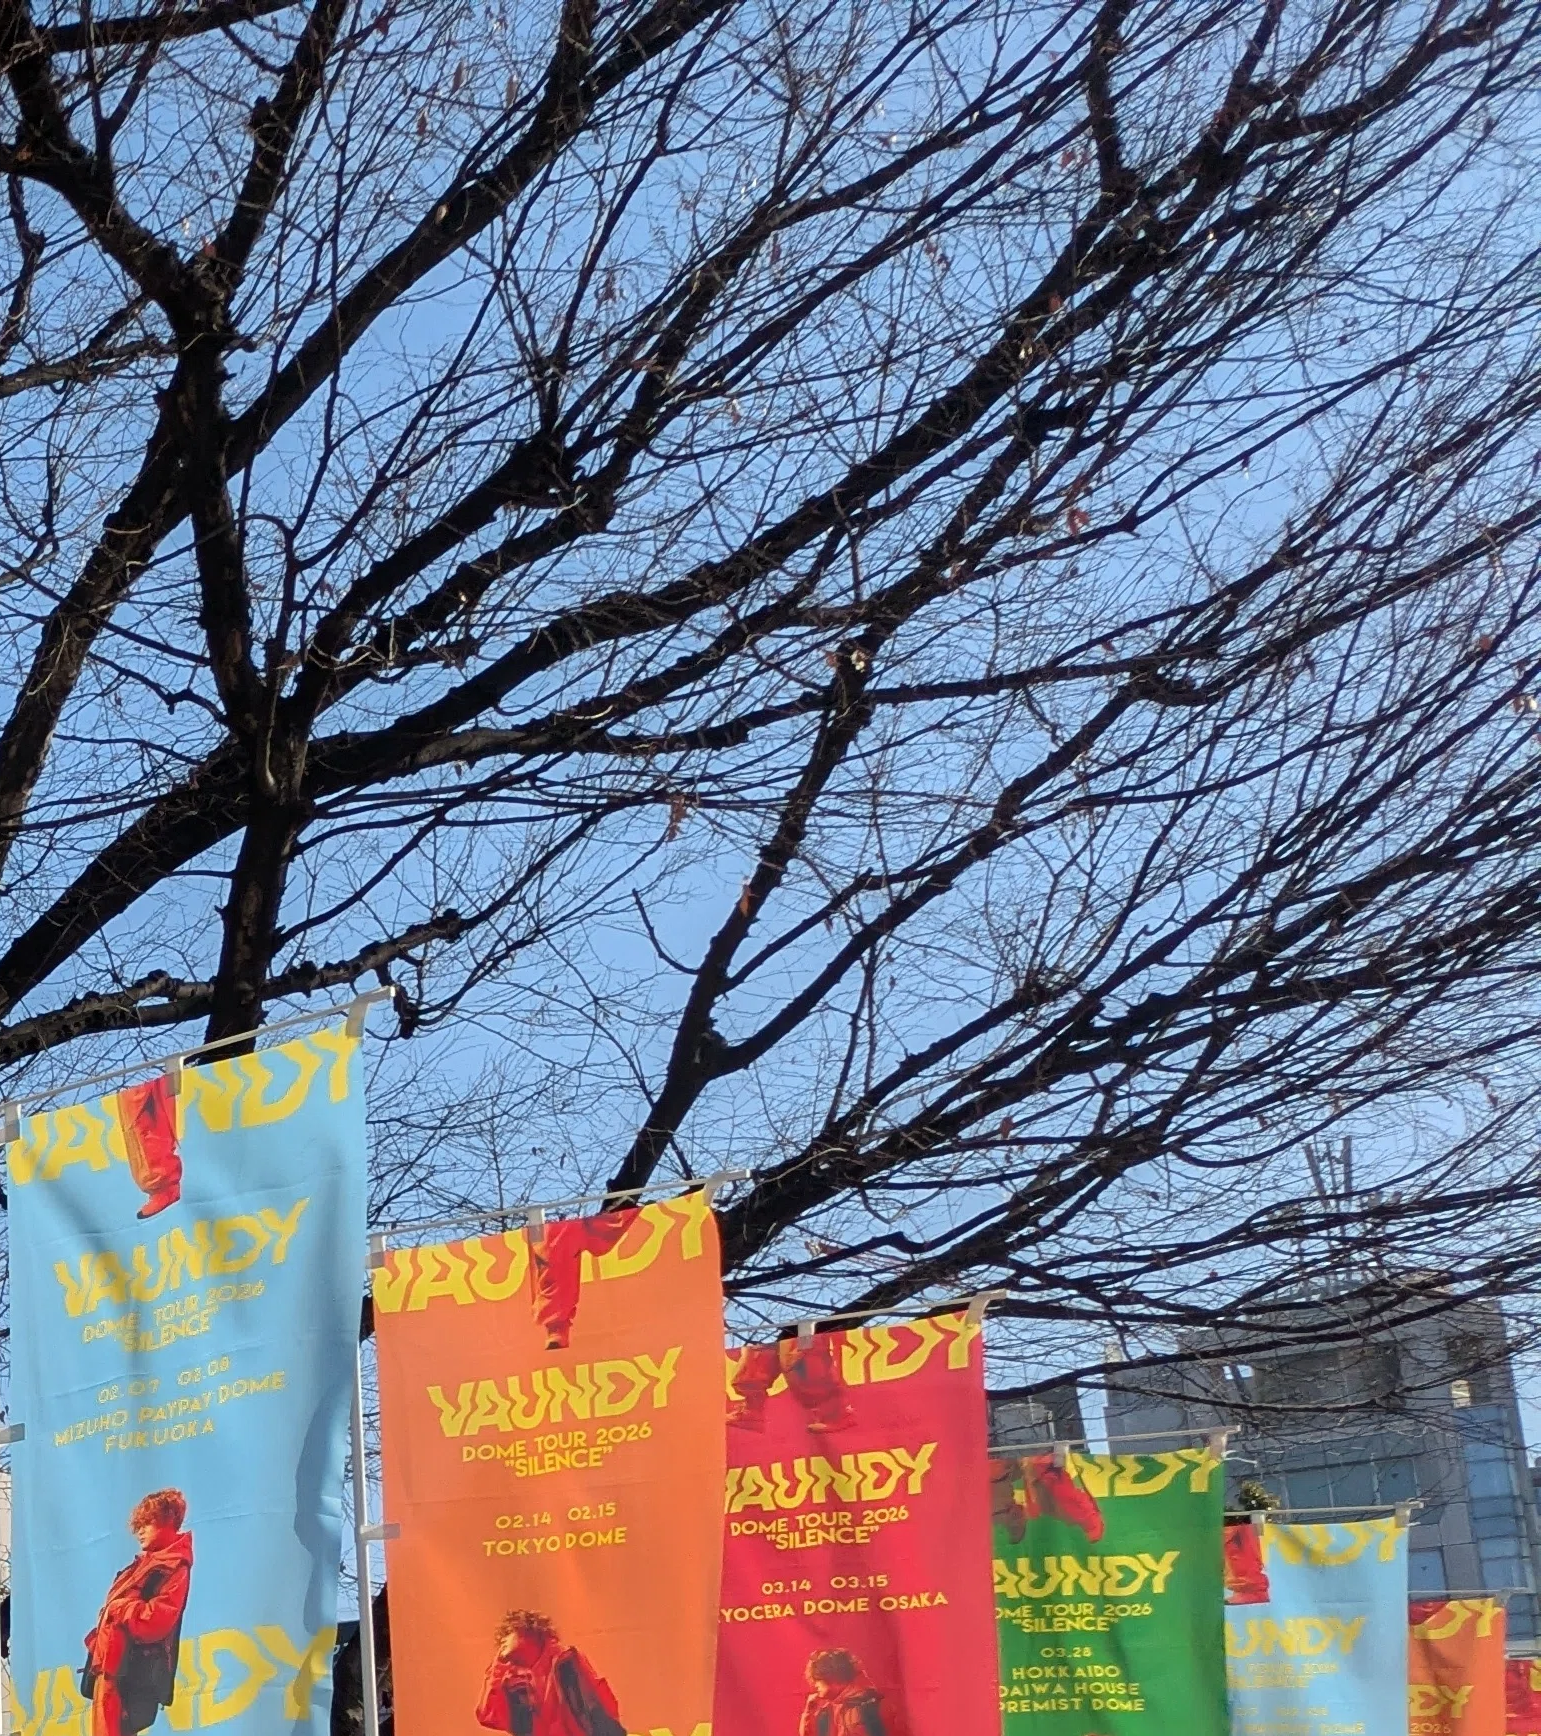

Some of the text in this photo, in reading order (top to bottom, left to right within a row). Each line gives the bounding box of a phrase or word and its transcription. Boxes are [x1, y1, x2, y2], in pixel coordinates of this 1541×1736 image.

[53, 1197, 312, 1319] VAUNDY
[82, 1310, 142, 1345] DOME
[153, 1293, 201, 1326] TOUR
[426, 1345, 683, 1438] VAUNDY
[53, 1369, 287, 1448] MIZUHO PAYPAY DOME
[462, 1421, 653, 1463] DOME TOUR 2026
[495, 1502, 617, 1530] 02.14 02.15
[730, 1504, 910, 1537] DOME TOUR 2026
[482, 1526, 628, 1557] TOKYO DOME
[761, 1574, 889, 1596] 03.14 03.15
[718, 1591, 949, 1625] YOCERA DOME OSAKA
[1042, 1602, 1095, 1618] TOUR
[1104, 1602, 1153, 1618] 2026
[1039, 1646, 1093, 1659] 03.28
[1012, 1665, 1121, 1680] HOKKAIDO
[999, 1682, 1140, 1698] DAIWA HOUSE
[1091, 1698, 1146, 1712] DOME
